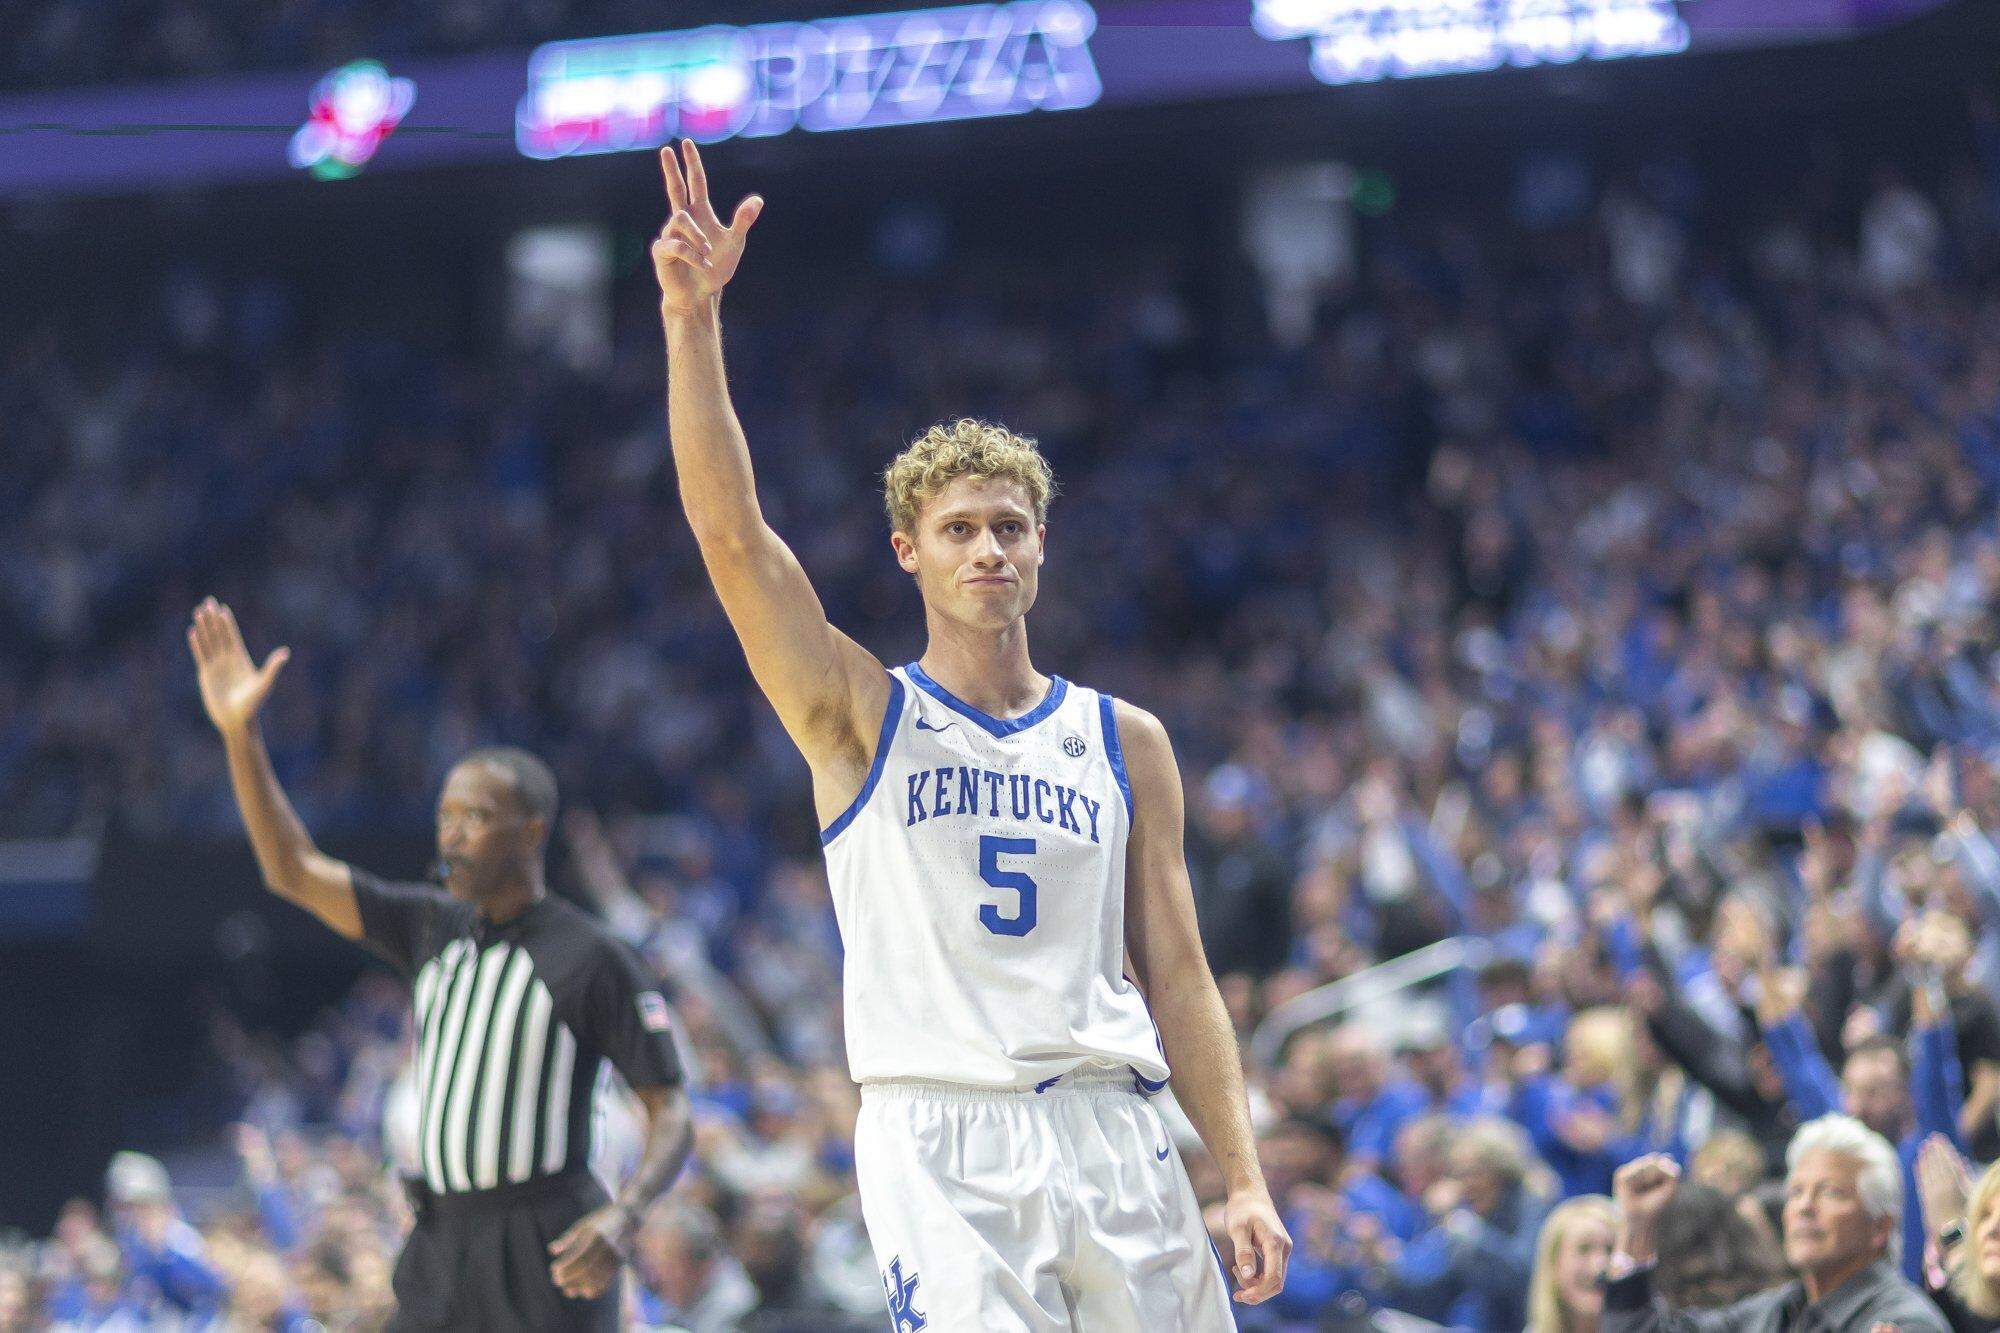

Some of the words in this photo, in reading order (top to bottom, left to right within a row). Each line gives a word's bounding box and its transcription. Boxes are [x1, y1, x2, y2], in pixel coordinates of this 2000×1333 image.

[1064, 737, 1085, 756] SEC
[906, 766, 1101, 844] KENTUCKY
[979, 835, 1037, 937] 5
